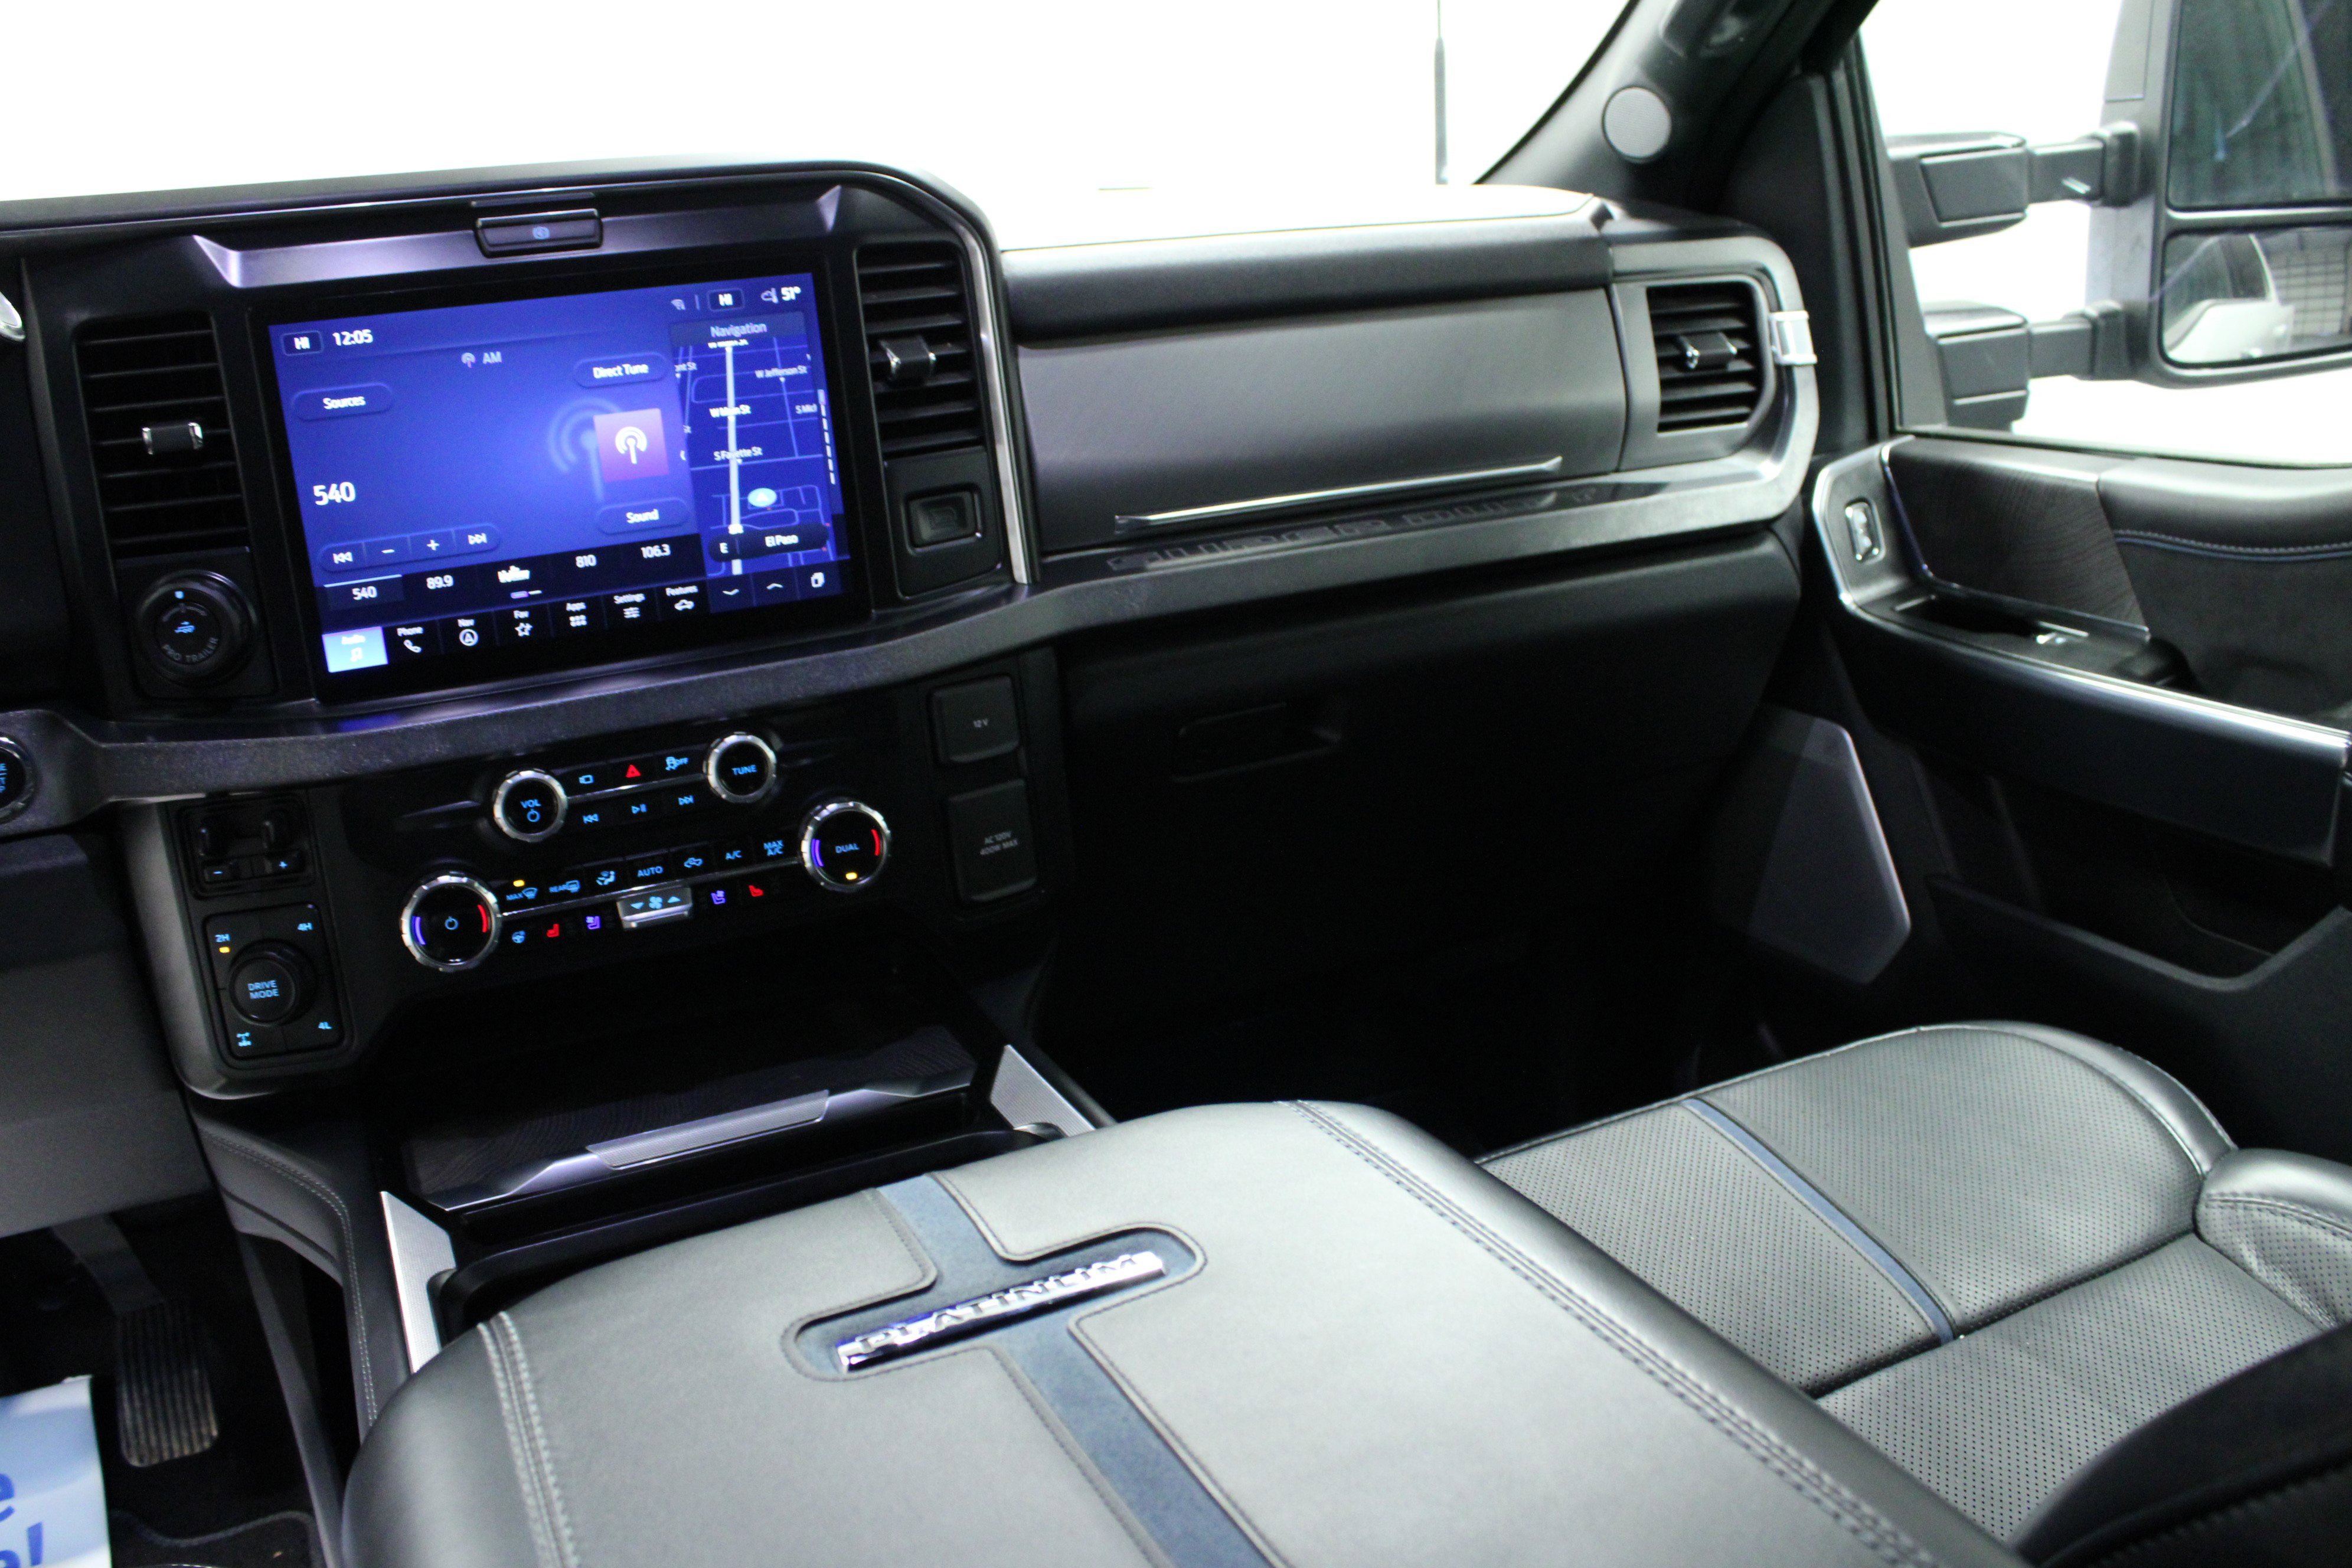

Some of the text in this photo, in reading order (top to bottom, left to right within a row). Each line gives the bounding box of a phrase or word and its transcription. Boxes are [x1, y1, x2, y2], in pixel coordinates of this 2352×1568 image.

[718, 293, 733, 307] HI
[710, 322, 767, 338] Navigation
[294, 337, 311, 349] HI
[332, 329, 373, 347] 12:05
[482, 351, 502, 365] AM
[592, 363, 649, 379] Direct Tune
[322, 394, 366, 410] Sources
[313, 482, 355, 506] 540
[626, 508, 659, 524] Sound
[641, 543, 671, 559] 106.3
[719, 543, 729, 554] E
[575, 554, 597, 569] 810
[426, 574, 454, 590] 89.9
[352, 586, 378, 600] 540
[665, 585, 698, 596] Features
[613, 593, 646, 605] Settings
[397, 626, 424, 637] Phone
[731, 764, 757, 776] TUNE
[520, 799, 541, 809] VOL
[764, 839, 784, 851] MAX
[835, 842, 860, 854] DUAL
[725, 850, 742, 861] A/C
[767, 847, 783, 857] A/C
[637, 865, 664, 878] AUTO
[297, 922, 313, 932] 4H
[214, 933, 230, 942] 2H
[247, 980, 277, 992] DRIVE
[249, 988, 280, 1000] MODE
[318, 1021, 332, 1031] 4L
